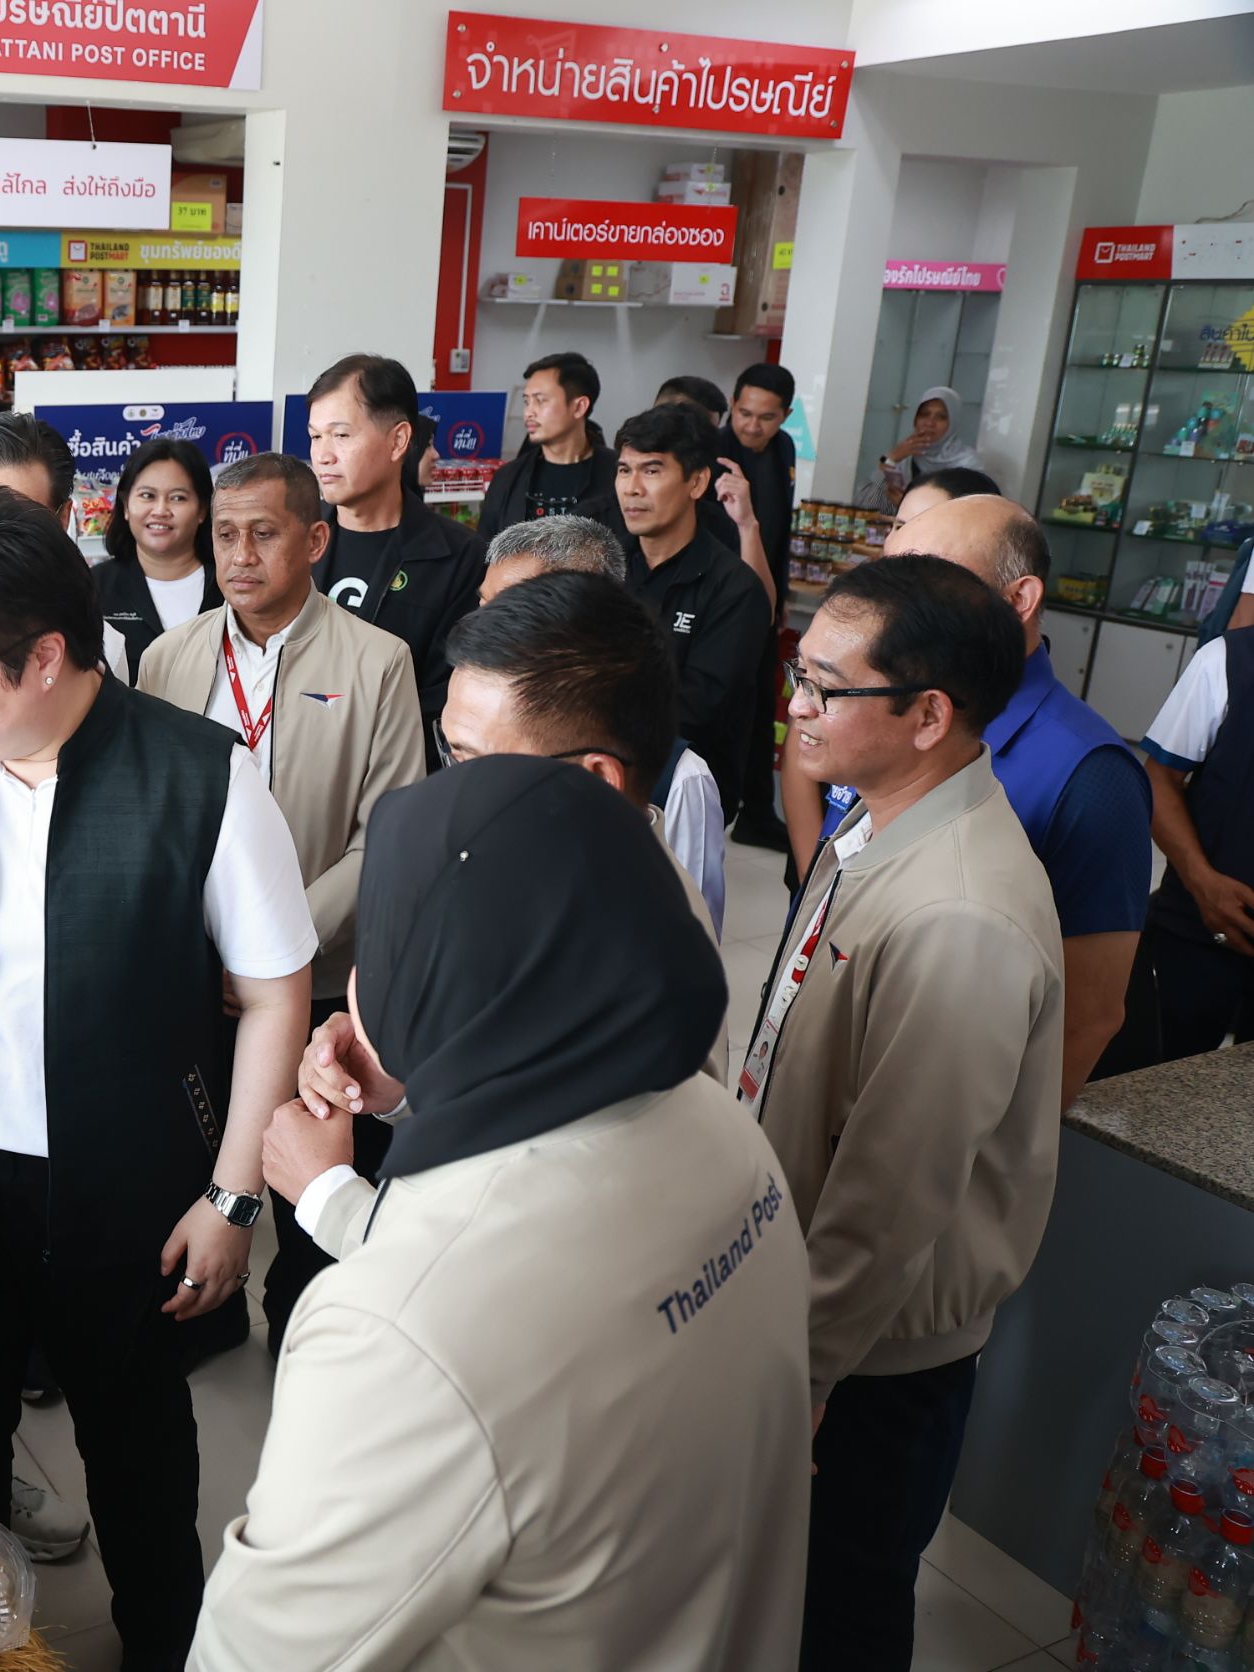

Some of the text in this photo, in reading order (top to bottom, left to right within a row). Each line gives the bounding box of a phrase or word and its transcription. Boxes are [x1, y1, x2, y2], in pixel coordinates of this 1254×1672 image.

[71, 43, 126, 66] POST
[132, 48, 206, 71] OFFICE
[465, 40, 837, 119] จำหน่ายสินค้าไปรษณีย์
[62, 175, 157, 198] ส่งให้ถึงมือ
[527, 217, 725, 247] เคาน์เตอร์ขายกล่องซอง
[89, 242, 130, 252] THAILAND
[89, 251, 130, 261] POSTMART
[1114, 251, 1155, 262] POSTMART
[1116, 243, 1157, 252] THAILAND
[657, 1171, 783, 1335] Thailand Post
